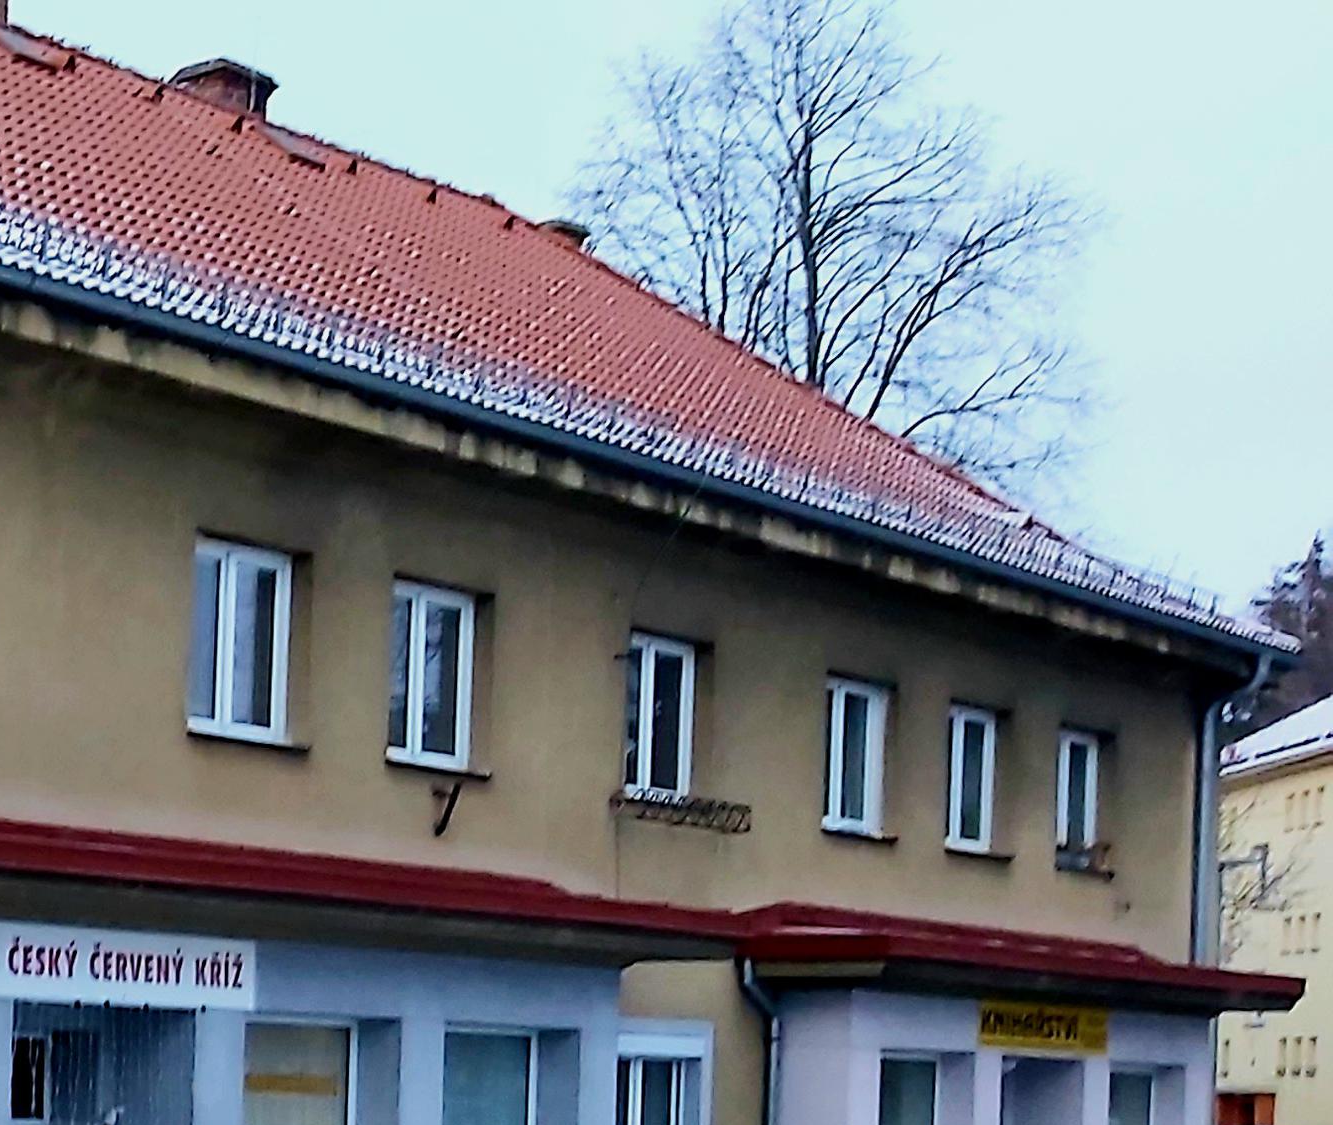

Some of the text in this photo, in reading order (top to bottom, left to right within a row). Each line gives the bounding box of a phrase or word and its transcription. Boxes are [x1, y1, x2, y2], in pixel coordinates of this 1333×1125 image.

[8, 935, 244, 989] ČESKÝ ČERVENÝ KŘÍŽ
